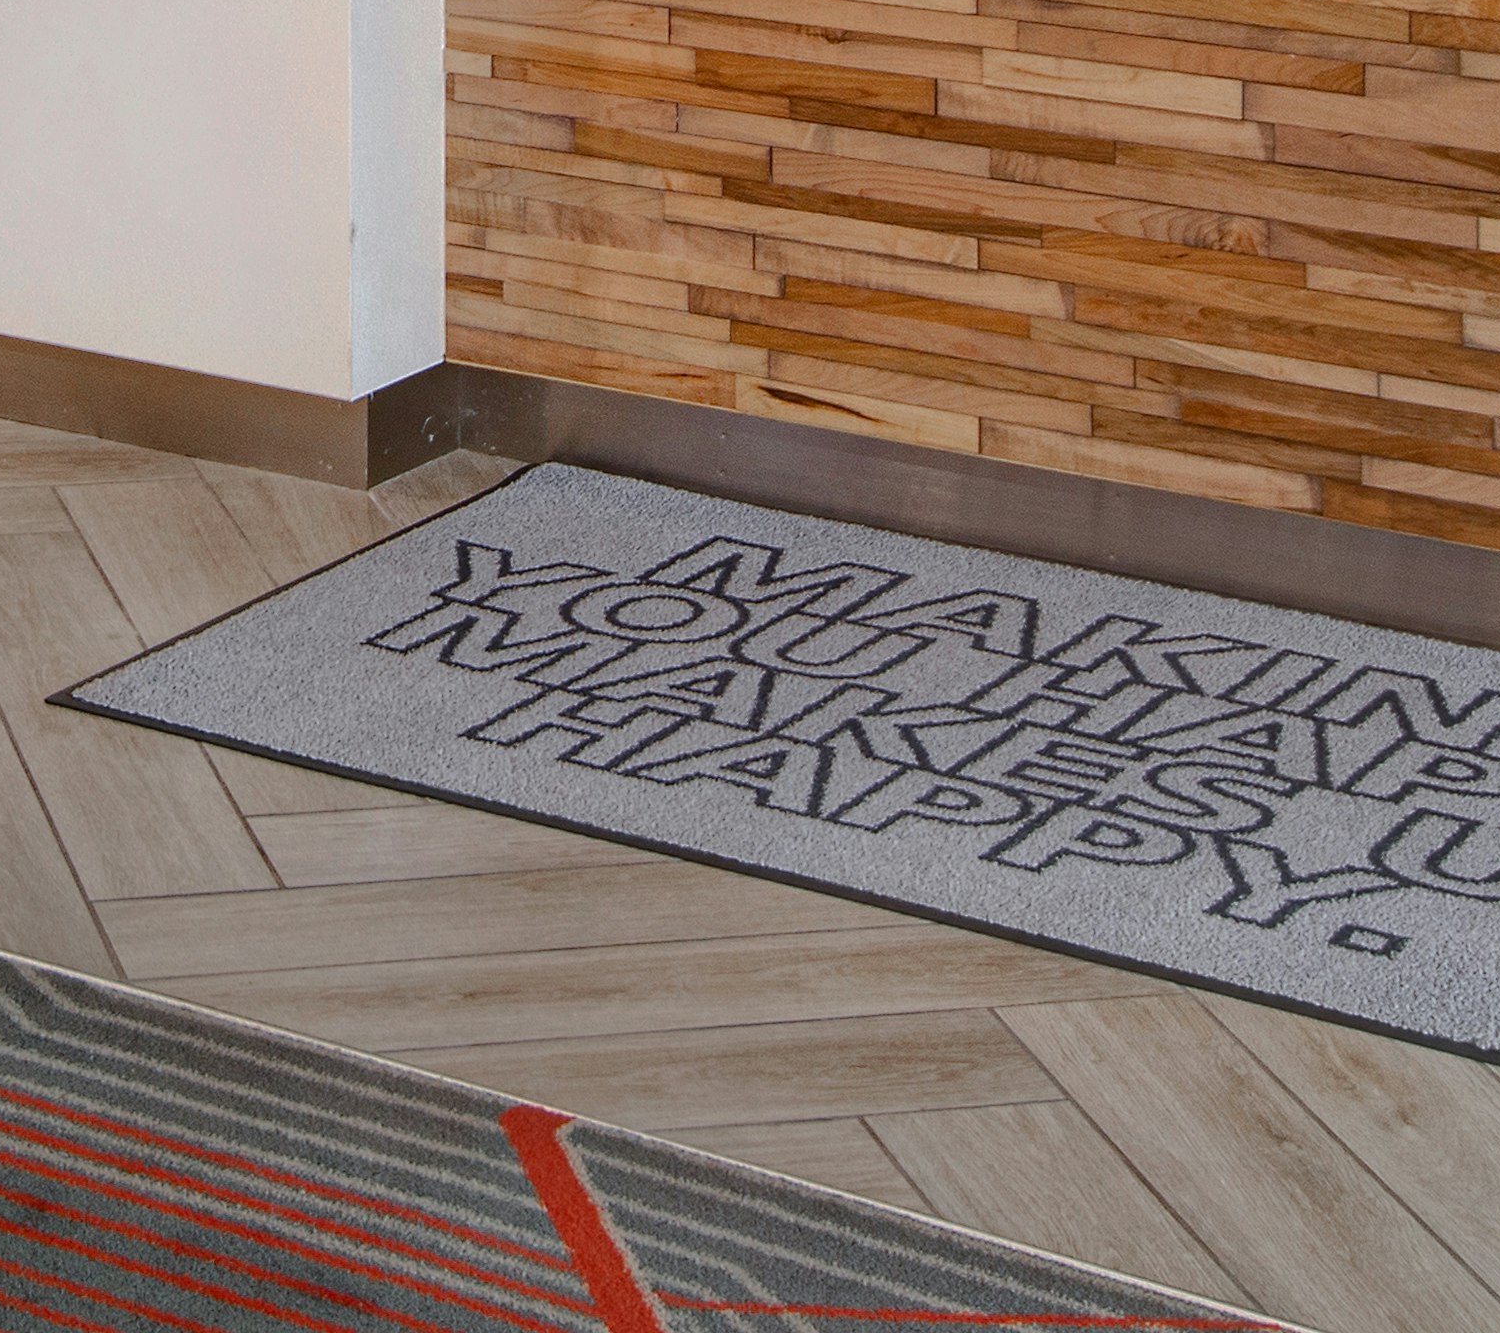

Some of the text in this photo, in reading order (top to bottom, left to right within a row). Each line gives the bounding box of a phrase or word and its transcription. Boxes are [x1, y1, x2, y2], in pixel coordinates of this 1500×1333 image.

[361, 599, 1302, 833] MAKES
[432, 540, 935, 680] YOU
[461, 687, 1404, 955] HAPPY.
